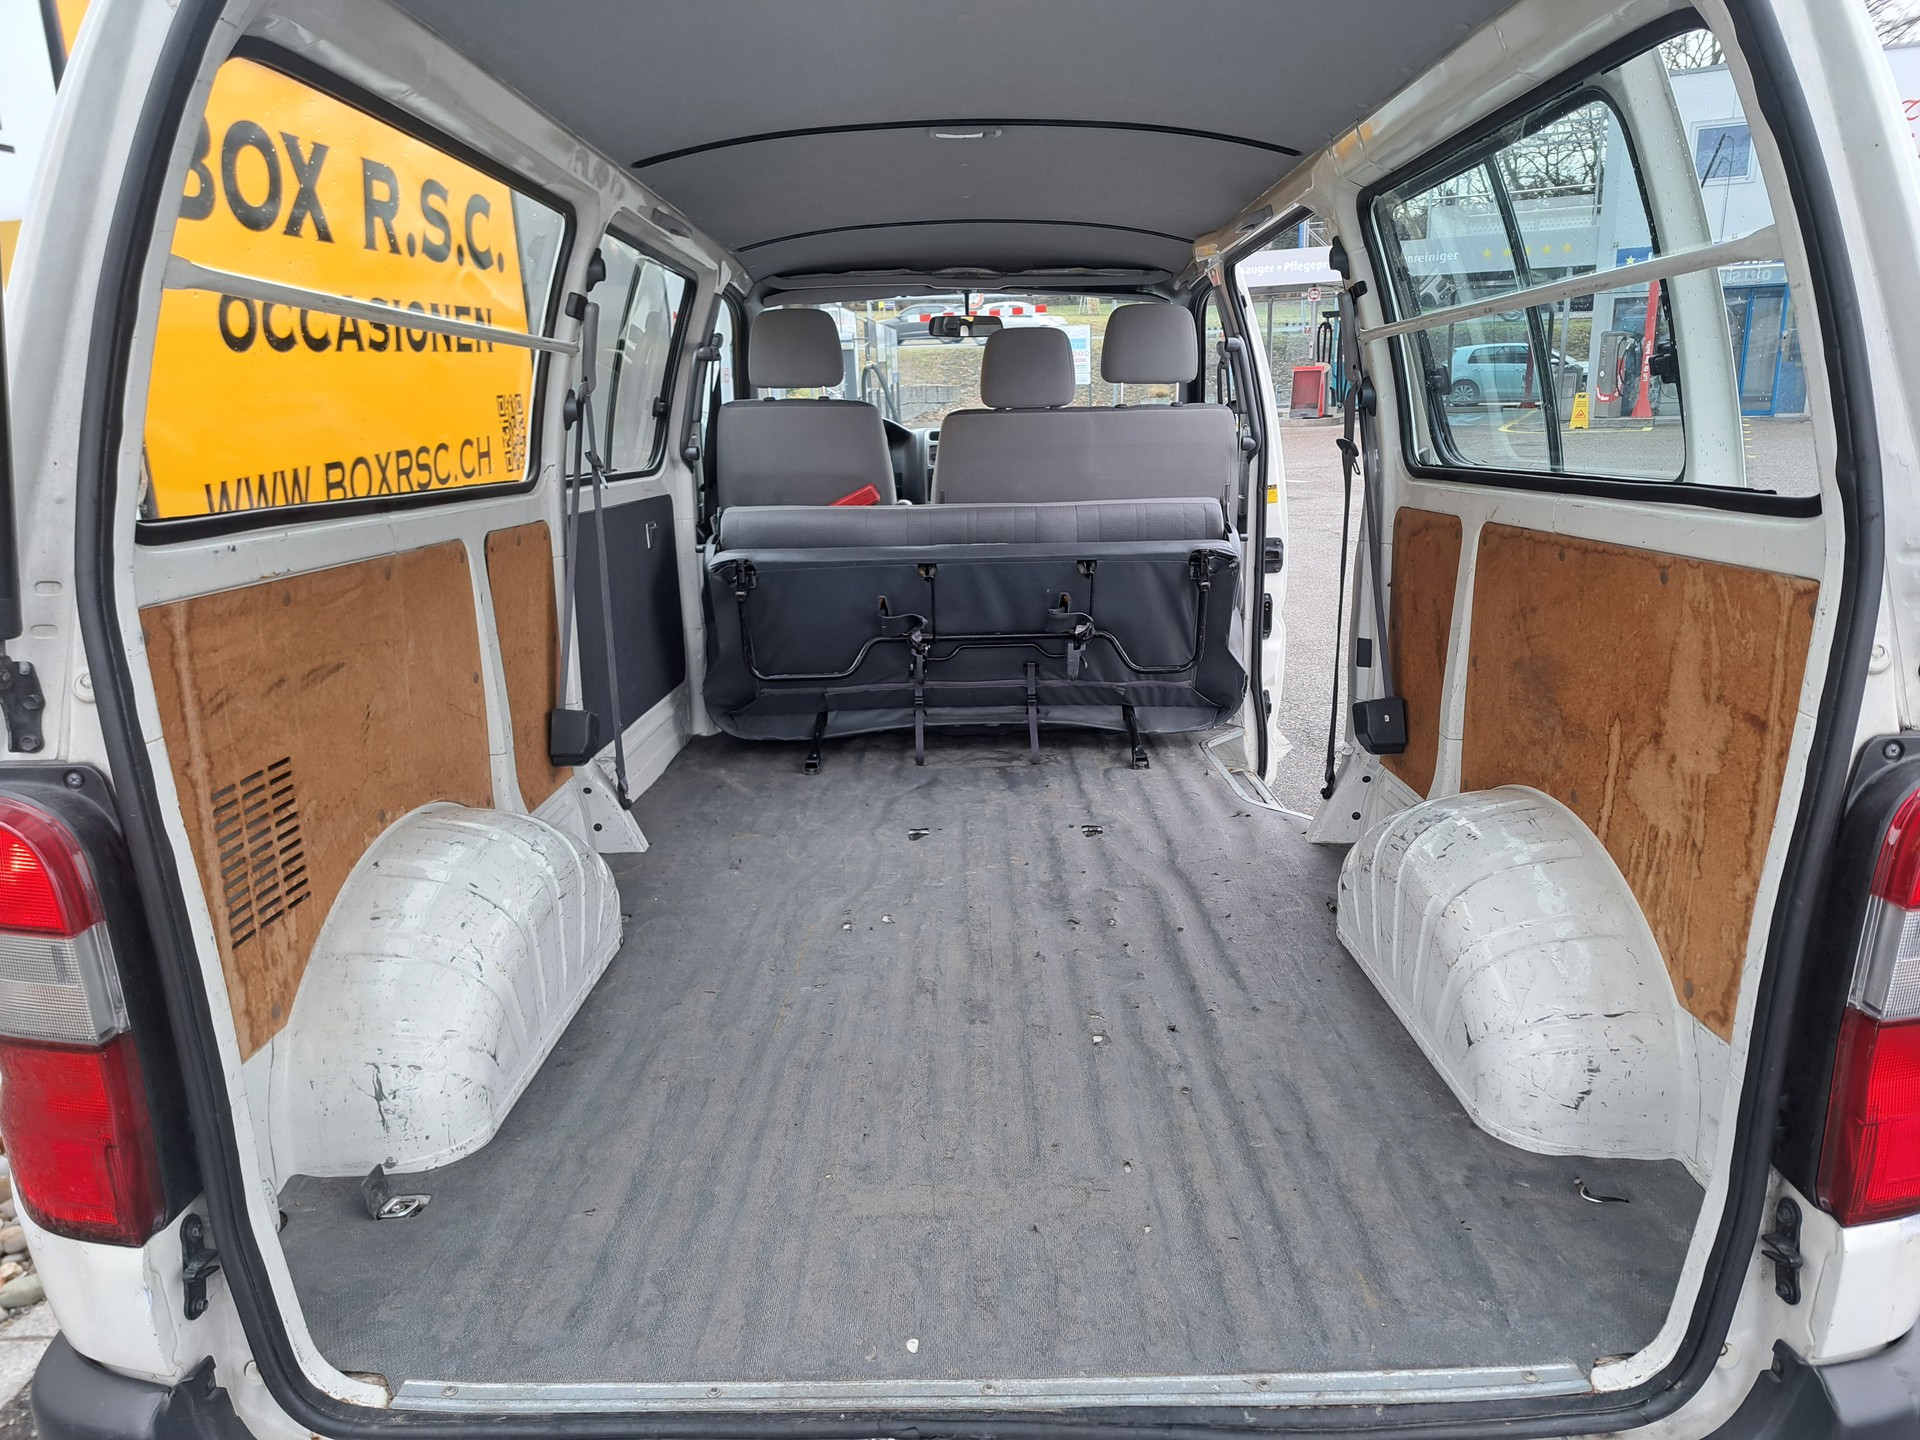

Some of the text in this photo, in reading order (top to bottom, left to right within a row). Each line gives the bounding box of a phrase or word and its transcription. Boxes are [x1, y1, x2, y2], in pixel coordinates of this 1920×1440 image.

[179, 115, 505, 273] BOX R.S.C.
[219, 293, 494, 353] OCCASIONEN
[204, 435, 492, 513] WWWBOXRSC.CH
